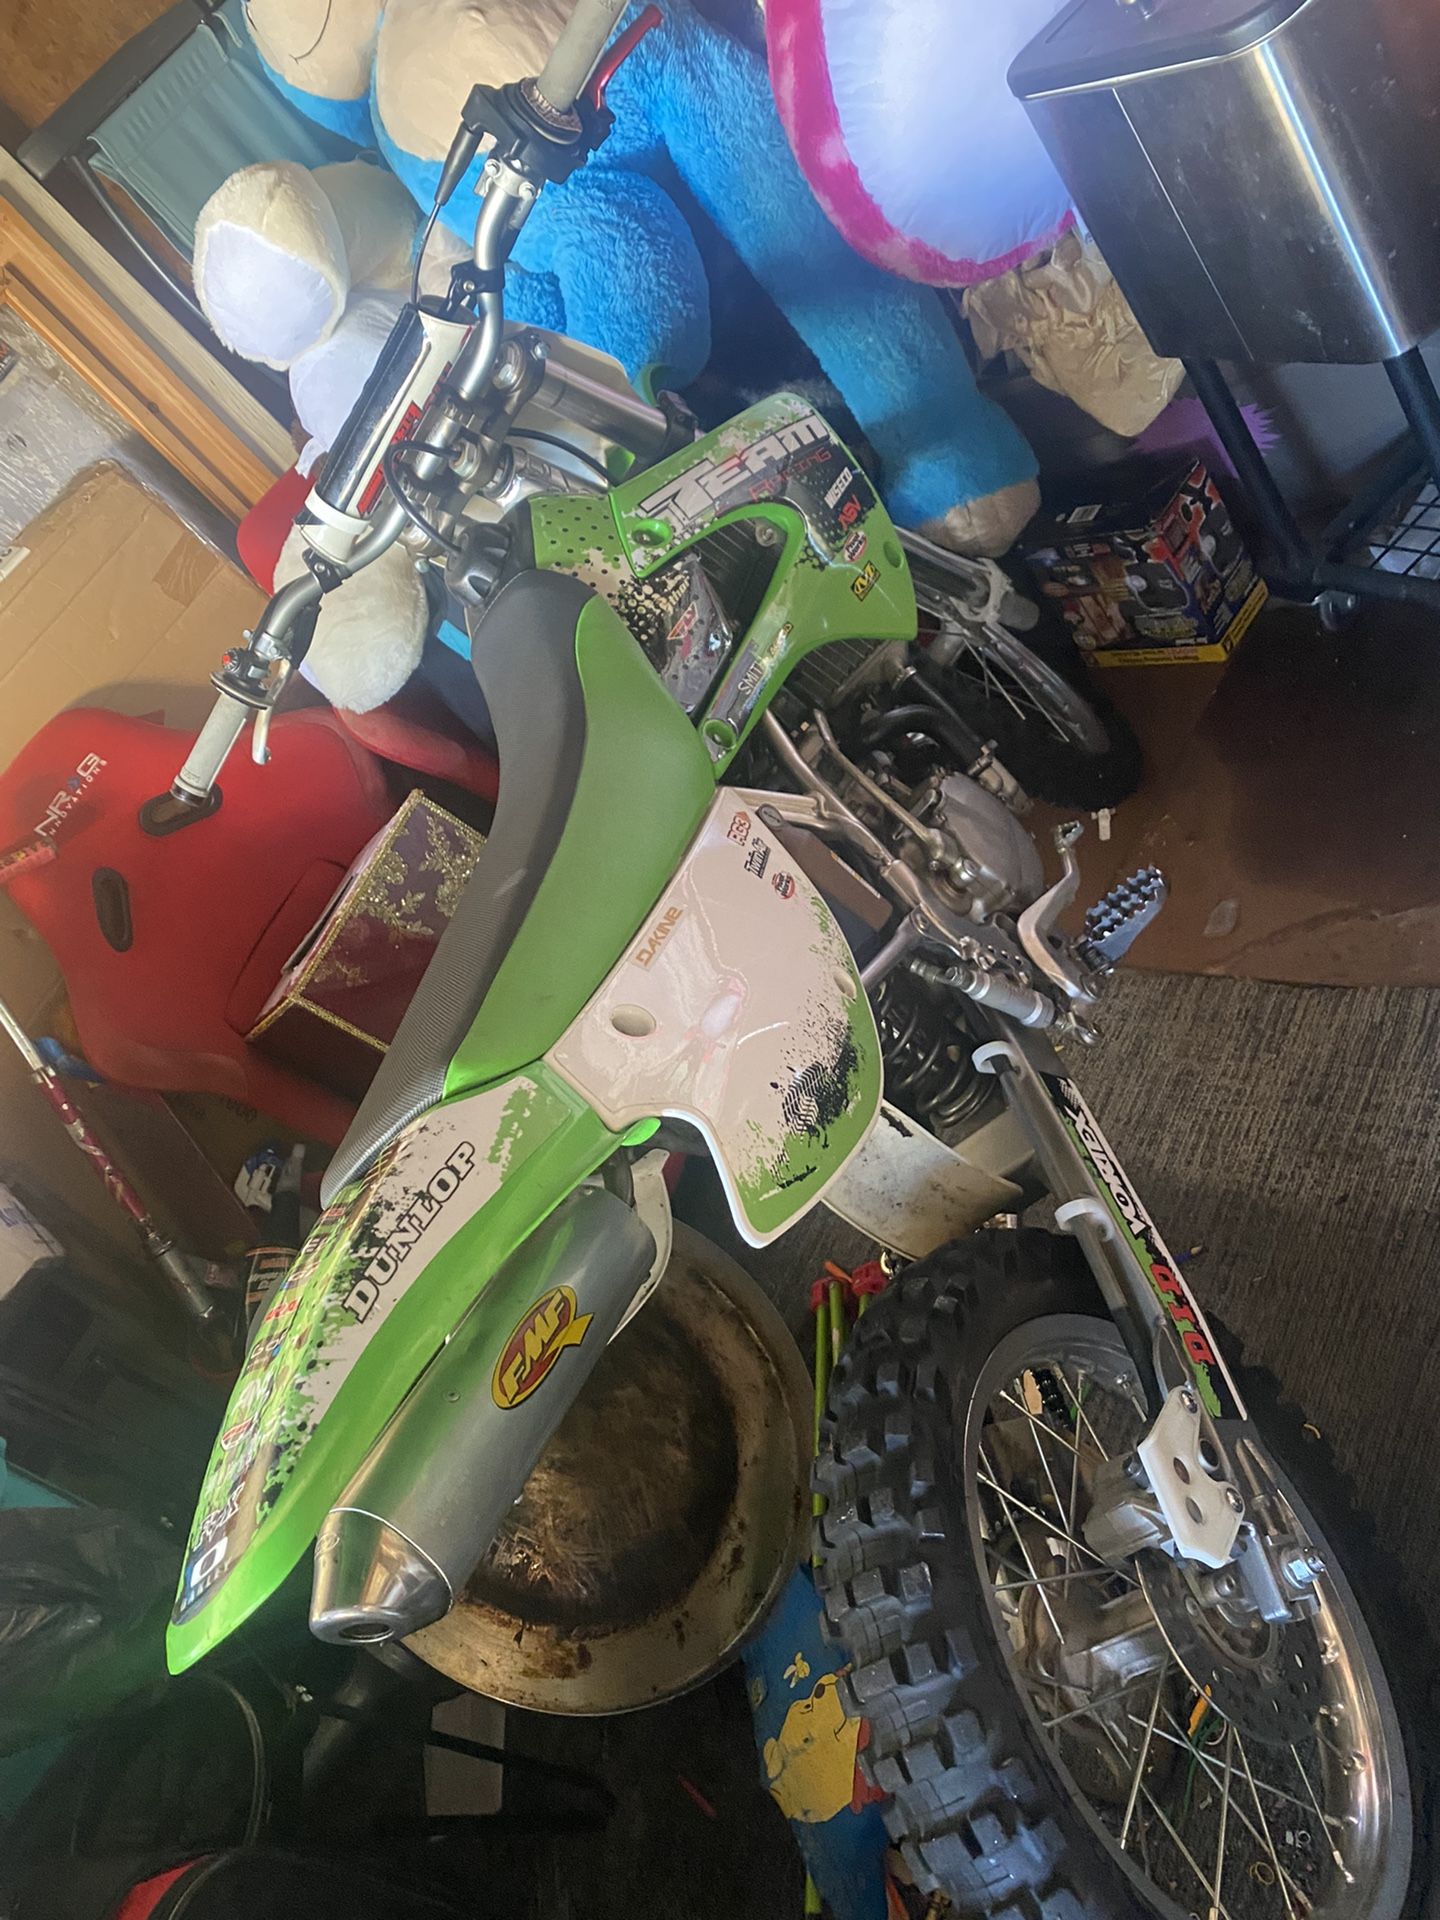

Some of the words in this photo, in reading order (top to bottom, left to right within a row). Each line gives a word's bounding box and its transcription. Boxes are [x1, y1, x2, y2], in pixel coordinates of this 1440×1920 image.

[638, 413, 830, 520] TEAM
[824, 466, 853, 509] WISECO
[838, 494, 861, 531] ASV
[33, 752, 102, 836] NRG
[635, 906, 683, 968] DAKINE
[1065, 1105, 1148, 1238] VORTEX
[341, 1141, 475, 1324] DUNLOP
[500, 1288, 565, 1404] FMF
